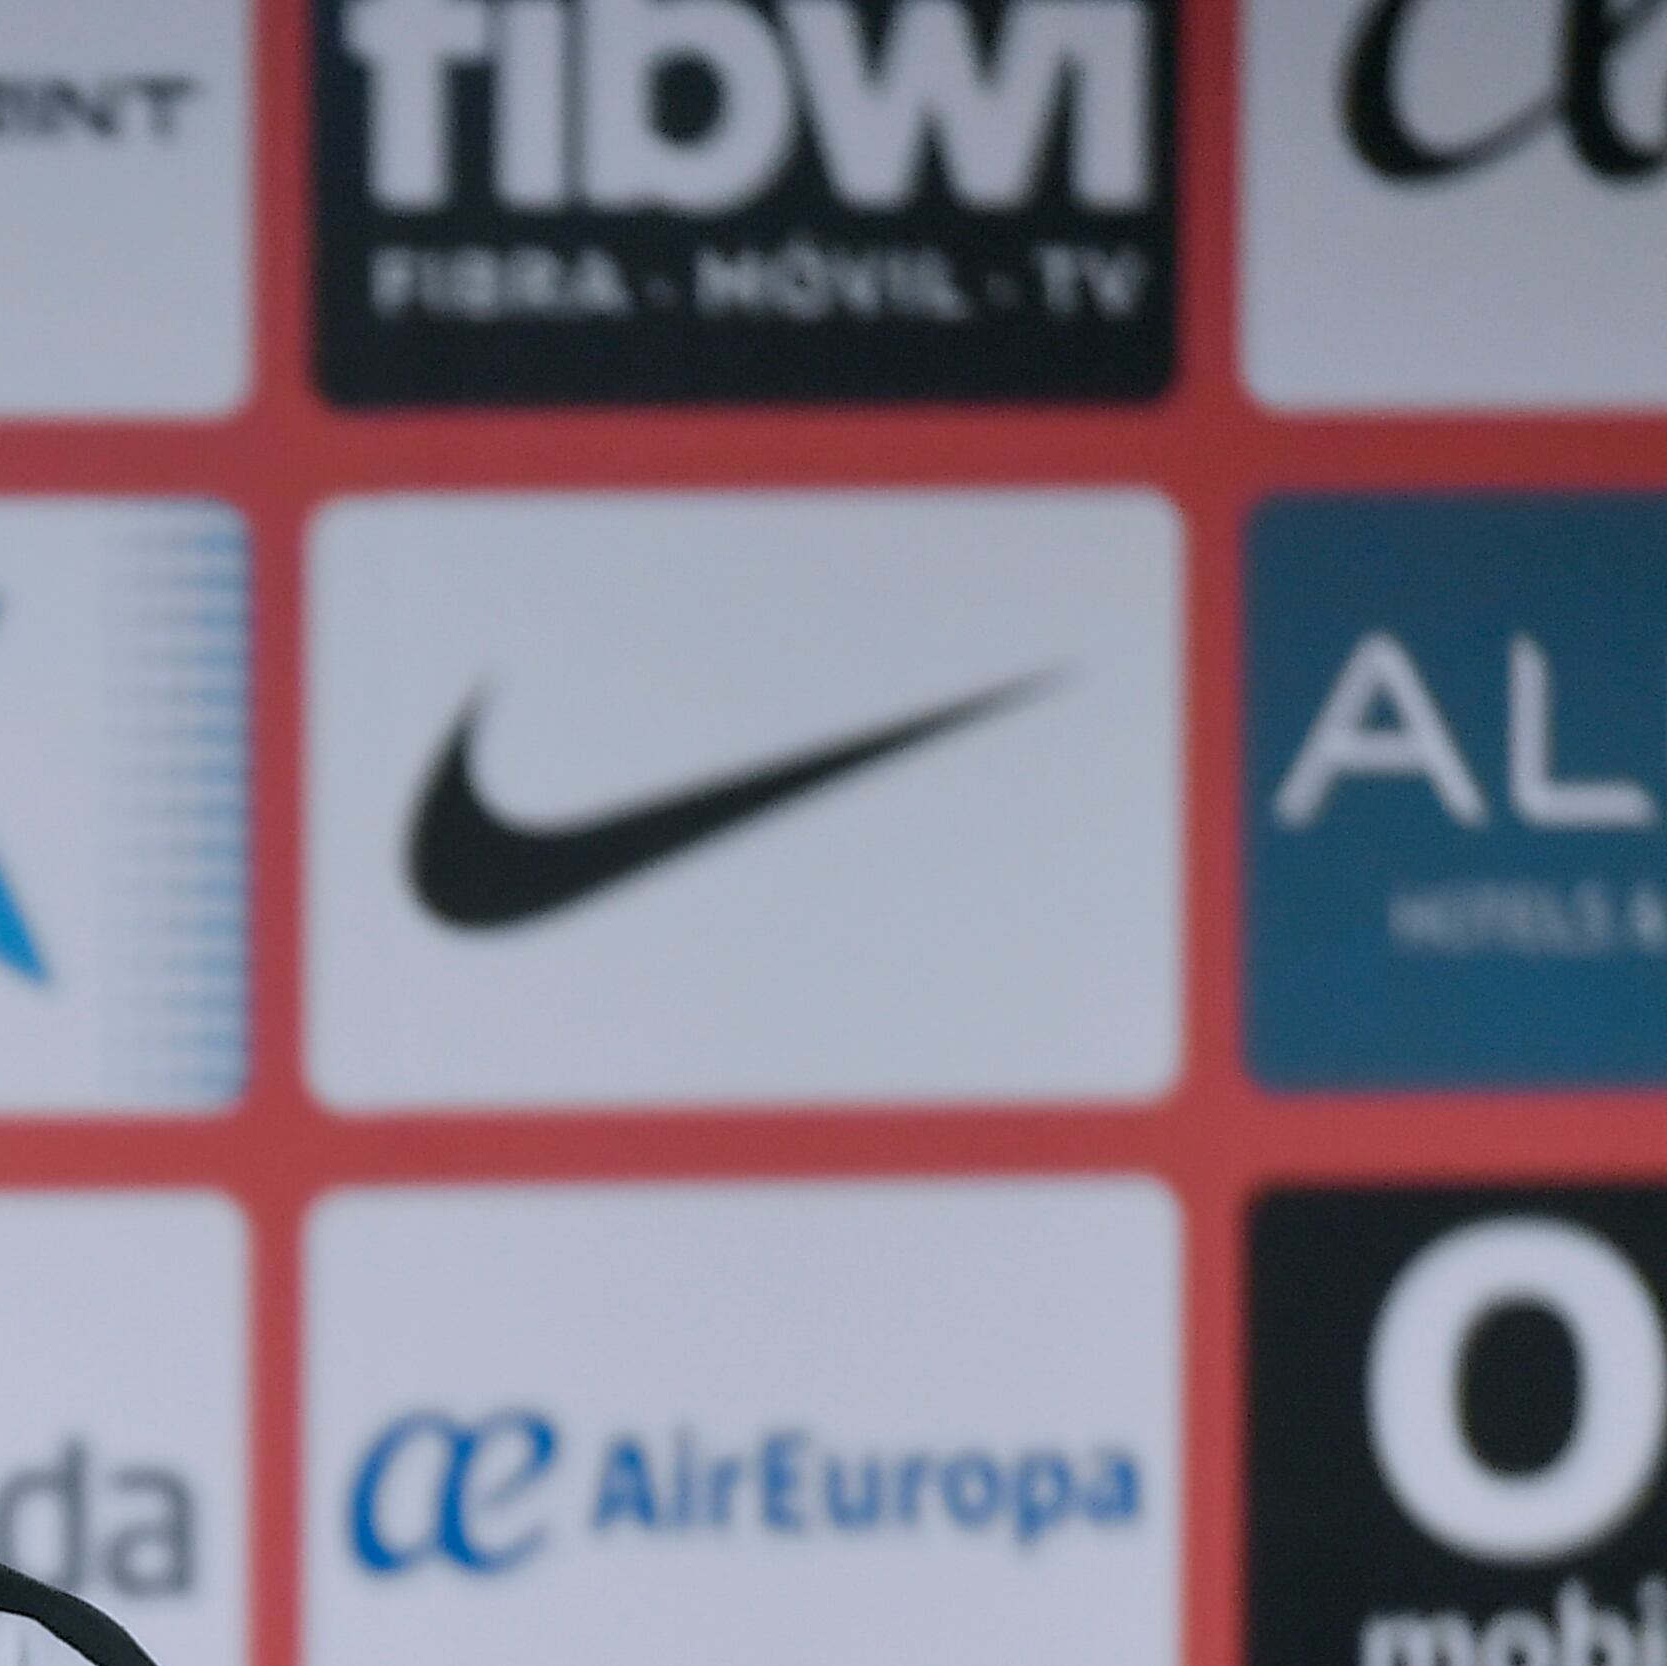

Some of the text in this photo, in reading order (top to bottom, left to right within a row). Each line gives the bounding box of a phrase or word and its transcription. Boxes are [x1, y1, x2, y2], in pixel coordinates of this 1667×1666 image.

[1041, 246, 1145, 318] TV
[1273, 630, 1657, 830] AL
[594, 1430, 1143, 1548] AirEuropa
